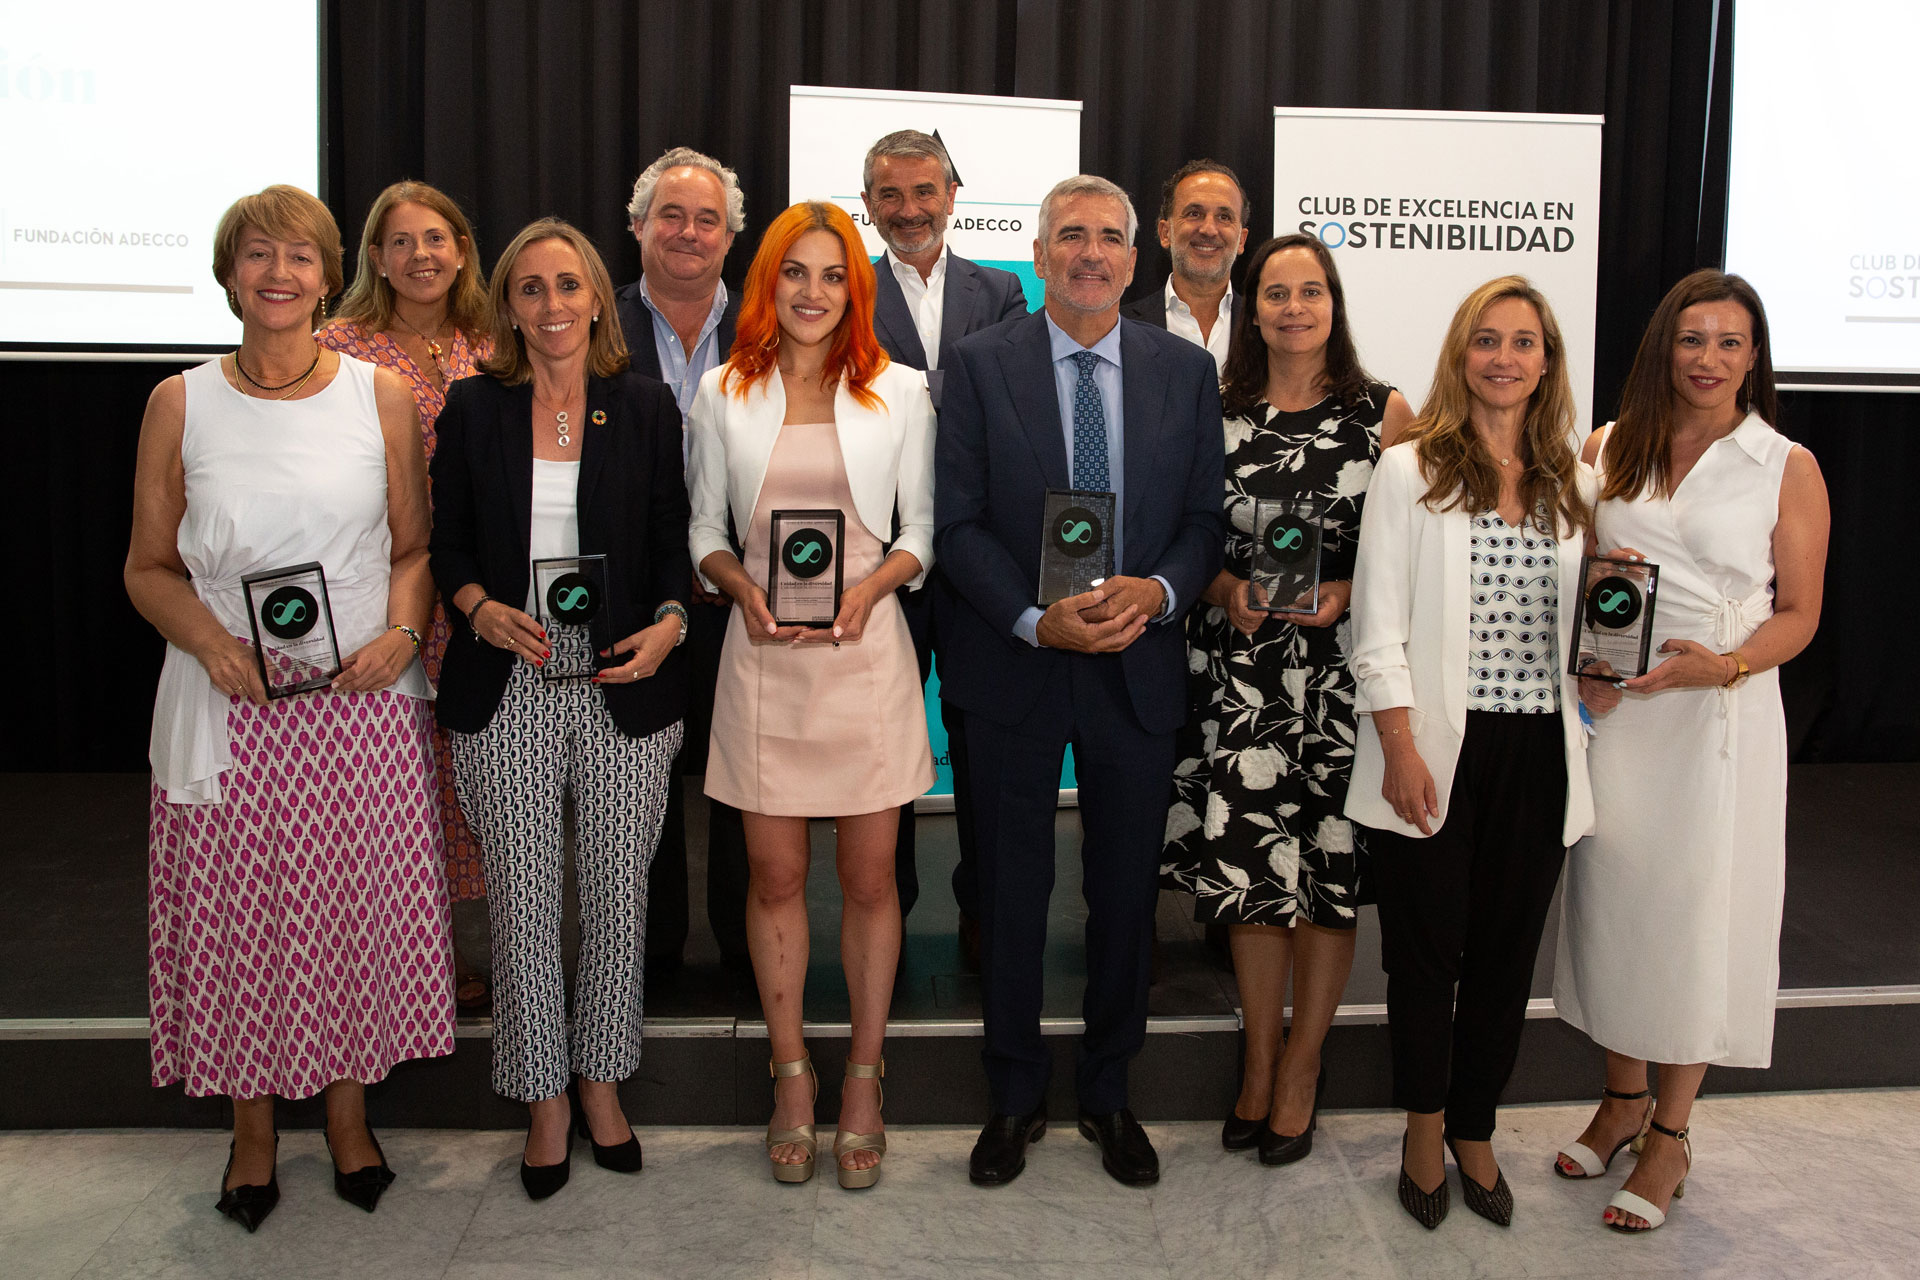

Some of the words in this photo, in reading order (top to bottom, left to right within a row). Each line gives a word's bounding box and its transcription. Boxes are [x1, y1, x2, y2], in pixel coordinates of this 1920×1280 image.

[1298, 196, 1356, 216] CLUB
[1363, 197, 1392, 217] DE
[1399, 198, 1538, 220] EXCELENCIA
[1543, 201, 1574, 221] EN
[953, 218, 1022, 232] ADECCO
[13, 228, 114, 245] FUNDACIÓN
[118, 232, 189, 247] ADECCO
[1298, 220, 1575, 253] SOSTENIBILIDAD
[1850, 254, 1897, 271] CLUB
[1848, 275, 1920, 299] SOST
